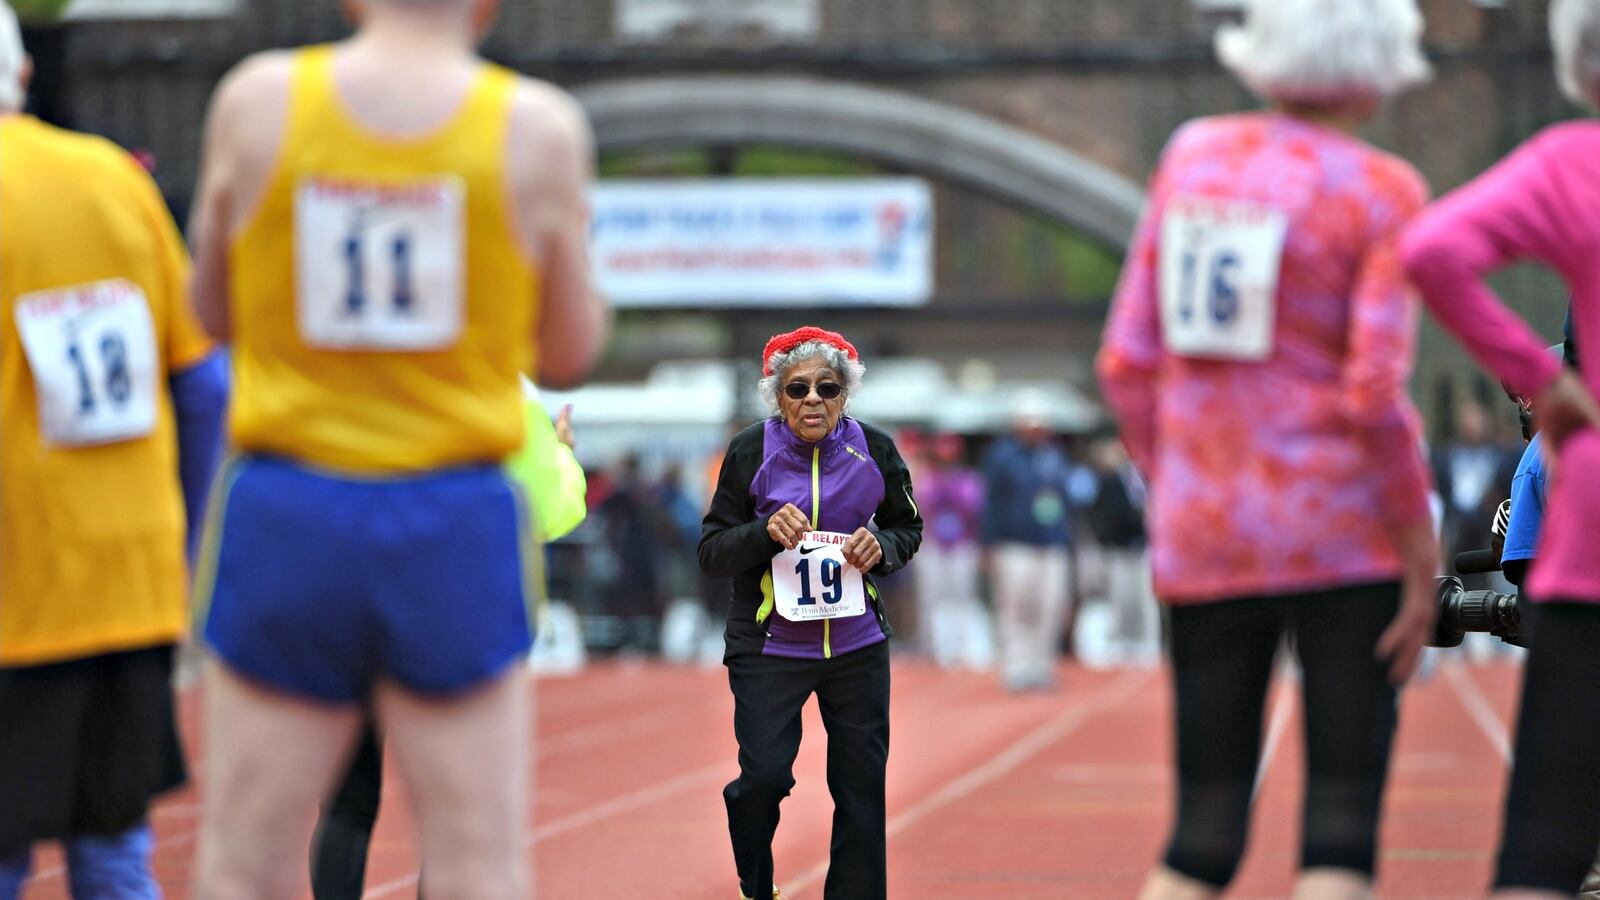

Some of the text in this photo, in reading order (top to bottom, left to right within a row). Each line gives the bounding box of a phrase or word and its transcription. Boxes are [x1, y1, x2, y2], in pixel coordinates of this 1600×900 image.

[340, 234, 417, 317] 11
[1178, 250, 1241, 327] 16
[66, 332, 132, 413] 18
[795, 558, 843, 606] 19
[801, 606, 819, 615] Penn
[819, 604, 850, 613] Medicine
